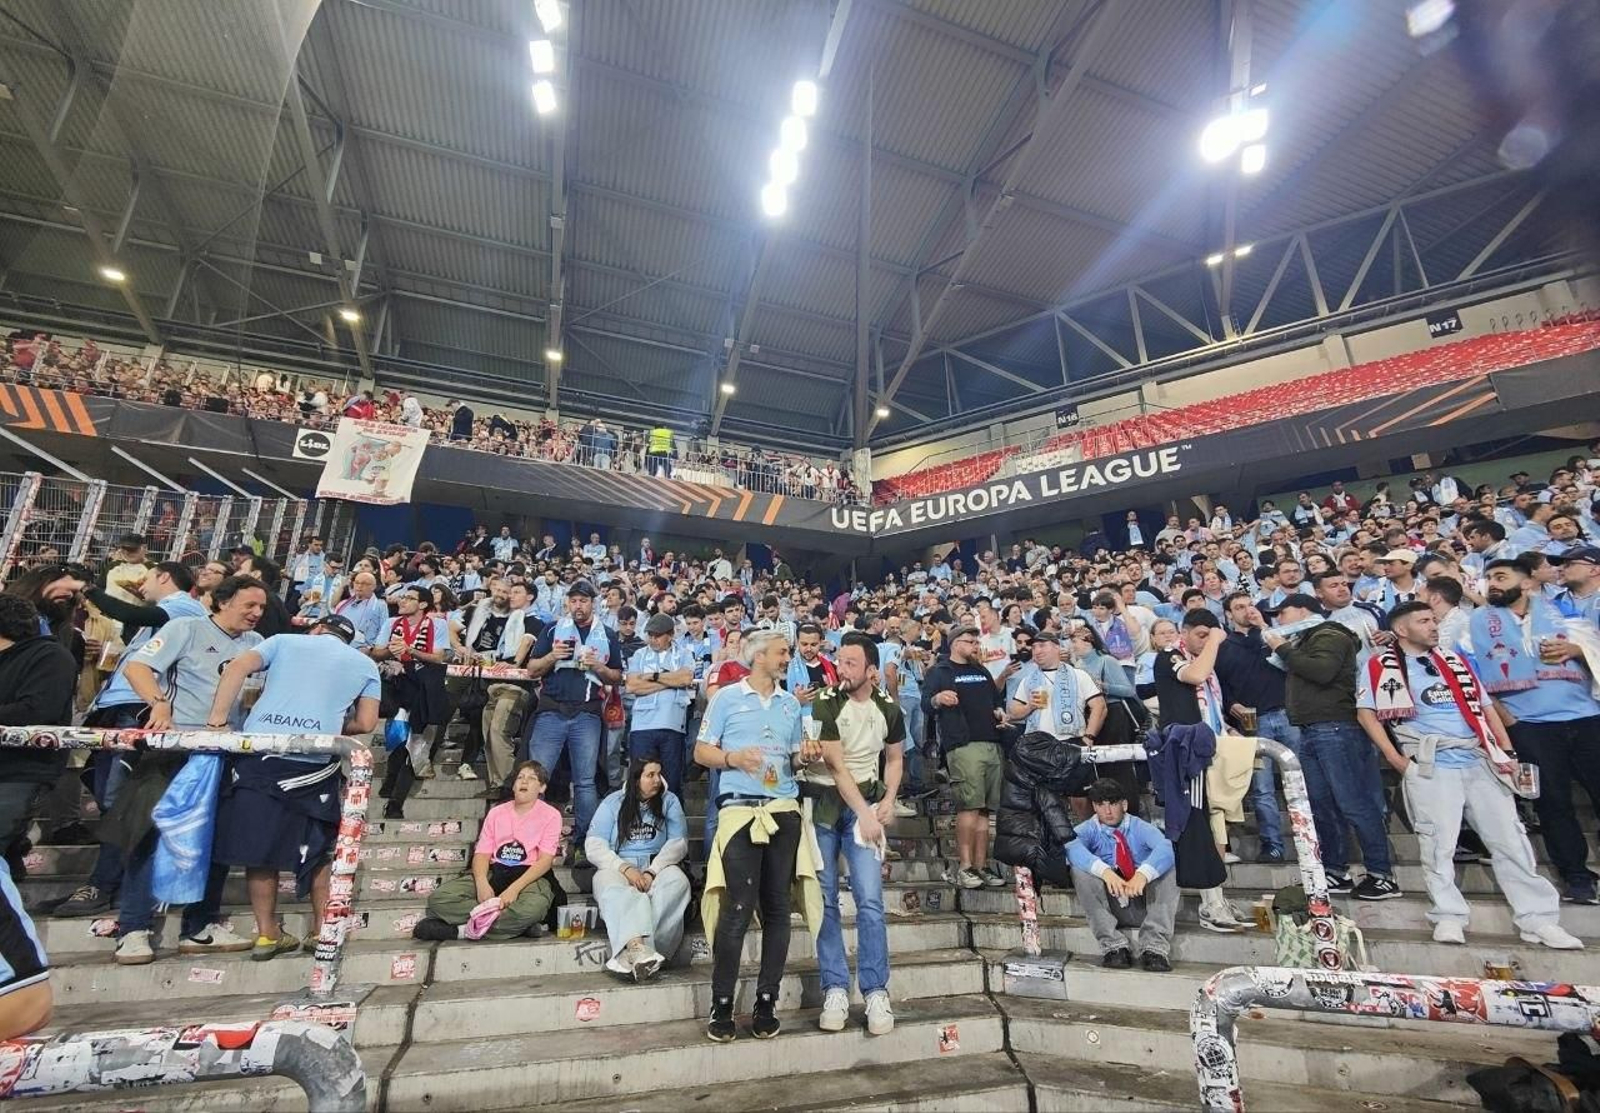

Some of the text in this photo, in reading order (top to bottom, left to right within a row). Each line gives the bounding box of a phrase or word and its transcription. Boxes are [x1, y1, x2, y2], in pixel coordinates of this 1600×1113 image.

[1430, 318, 1457, 333] N17
[831, 506, 903, 533] UEFA
[910, 480, 1033, 525] EUROPA
[259, 713, 321, 731] ABANCA
